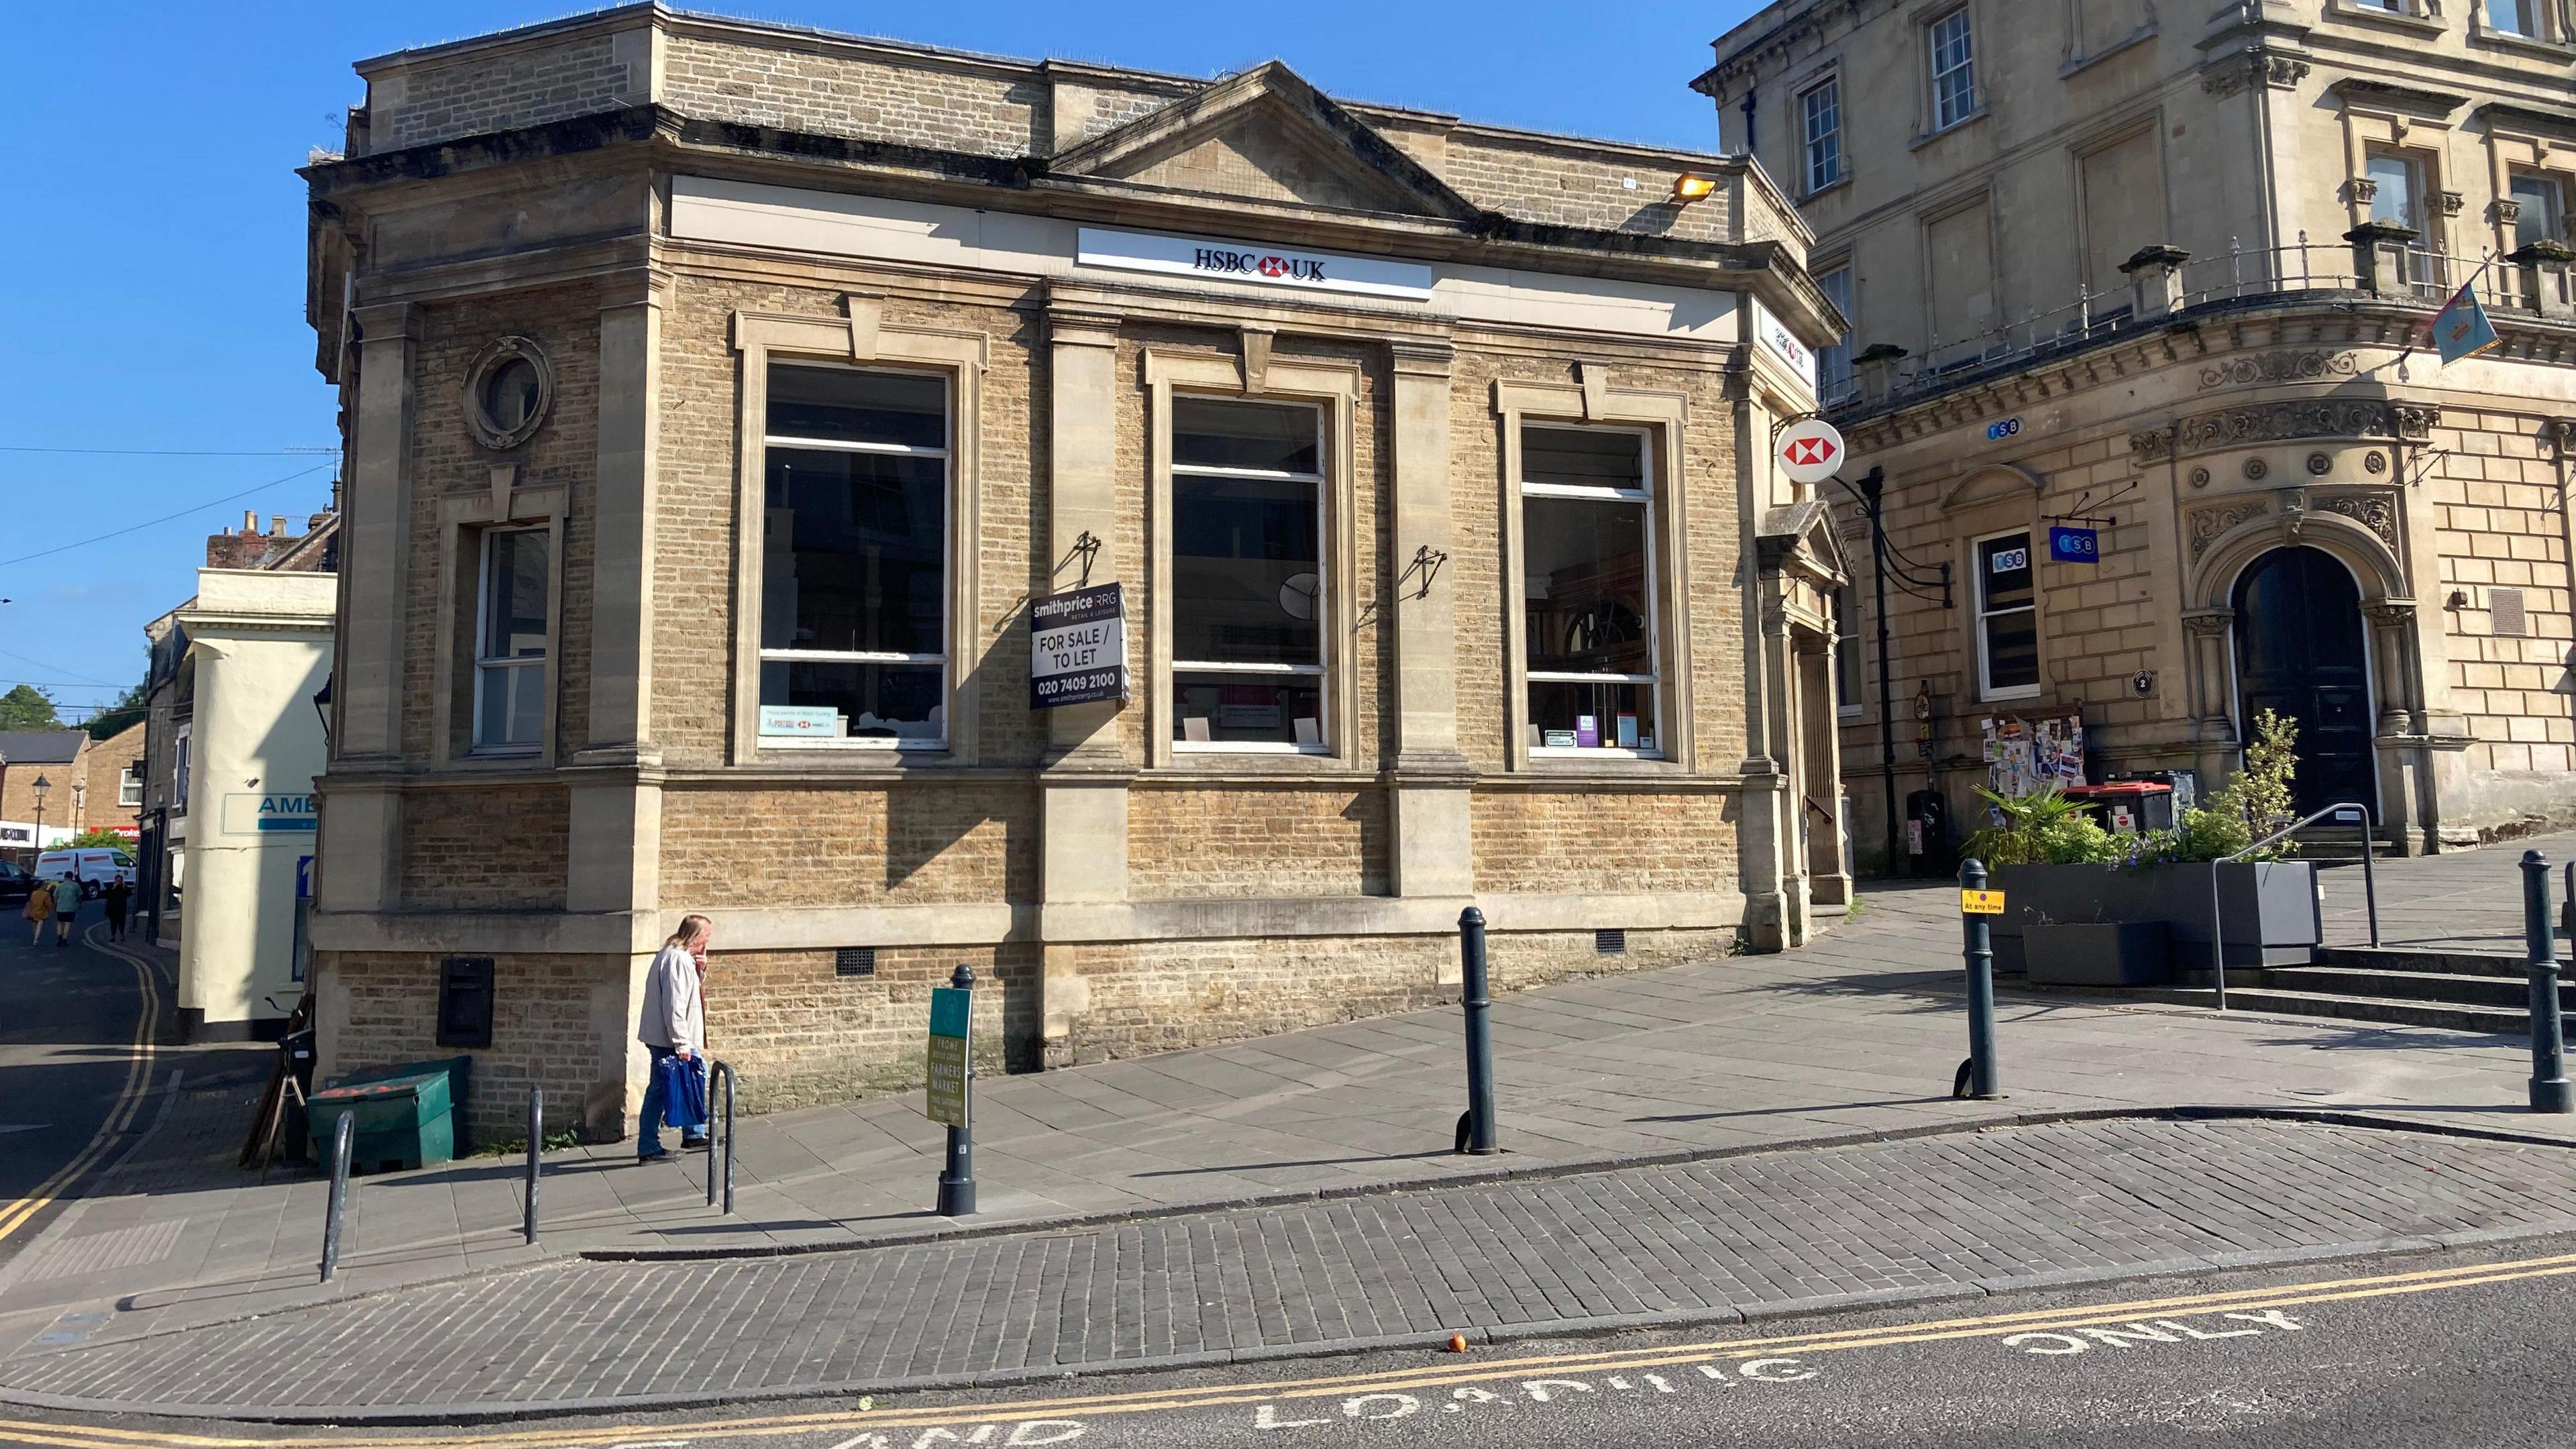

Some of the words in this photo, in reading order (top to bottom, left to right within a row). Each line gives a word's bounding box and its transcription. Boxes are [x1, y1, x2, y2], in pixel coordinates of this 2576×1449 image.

[1193, 248, 1255, 274] HSBC
[1292, 259, 1326, 282] UK
[1990, 421, 2017, 438] TSB
[2063, 538, 2092, 551] TSB
[1996, 553, 2023, 568] TSB
[1034, 596, 1093, 617] smithprice
[1095, 607, 1116, 616] LEISURE
[1040, 635, 1064, 652] FOR
[1069, 628, 1099, 647] SALE
[1104, 624, 1110, 645] /
[1053, 653, 1070, 669] TO
[1075, 649, 1096, 666] LET
[1038, 680, 1058, 695] 020
[1061, 676, 1087, 692] 7409
[1089, 672, 1116, 688] 2100
[2140, 680, 2145, 688] 2
[1048, 691, 1104, 703] www.smithpricerrg.co.uk
[937, 1039, 958, 1051] FROME
[932, 1079, 959, 1094] MARKET
[2002, 1309, 2304, 1355] ONLY
